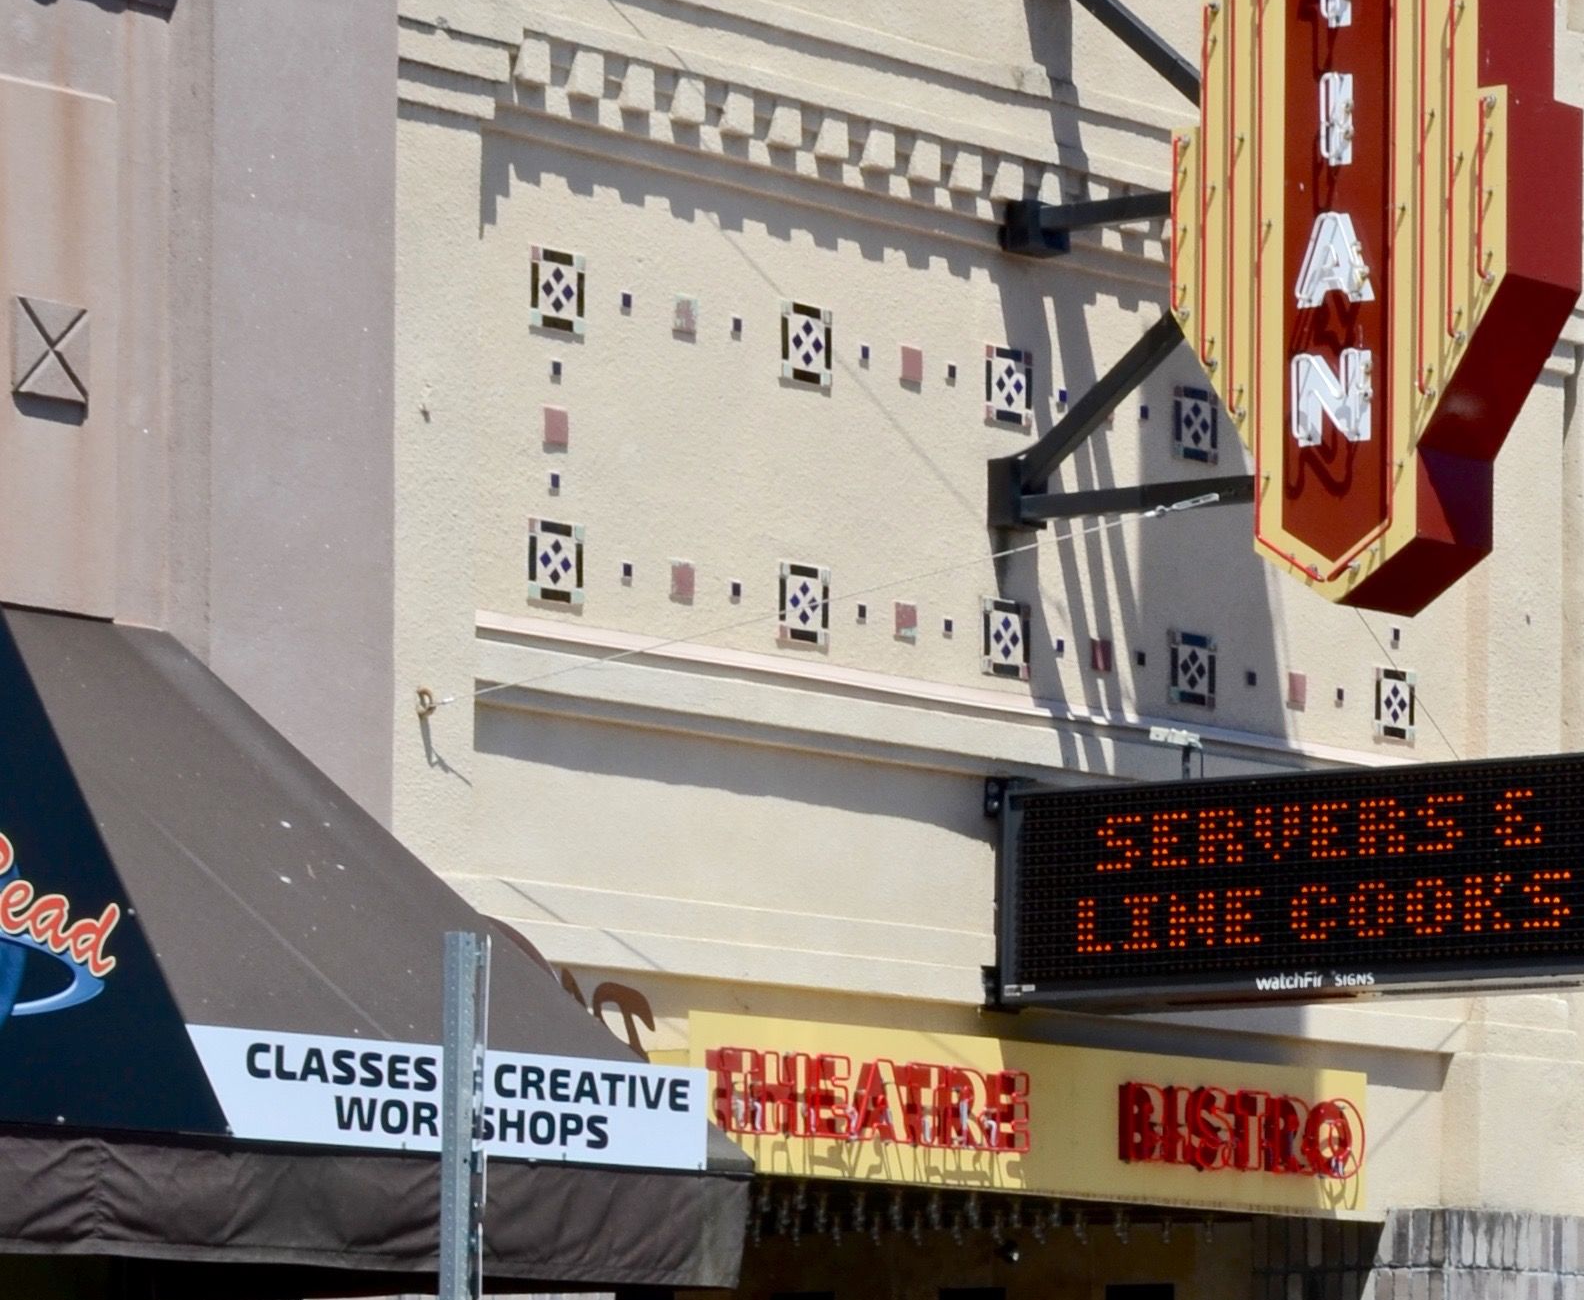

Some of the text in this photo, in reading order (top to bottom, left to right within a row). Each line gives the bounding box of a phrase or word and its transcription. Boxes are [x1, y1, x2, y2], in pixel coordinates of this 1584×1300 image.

[1096, 792, 1465, 872] SERVERS
[1076, 870, 1572, 954] LINE COOKS
[1255, 970, 1375, 990] watchFir SIGNS
[245, 1042, 437, 1093] CLASSES
[493, 1062, 691, 1113] CREATIVE
[705, 1046, 1031, 1154] THEATRE
[335, 1095, 609, 1150] WORSHOPS
[1118, 1079, 1366, 1179] BISTRO
